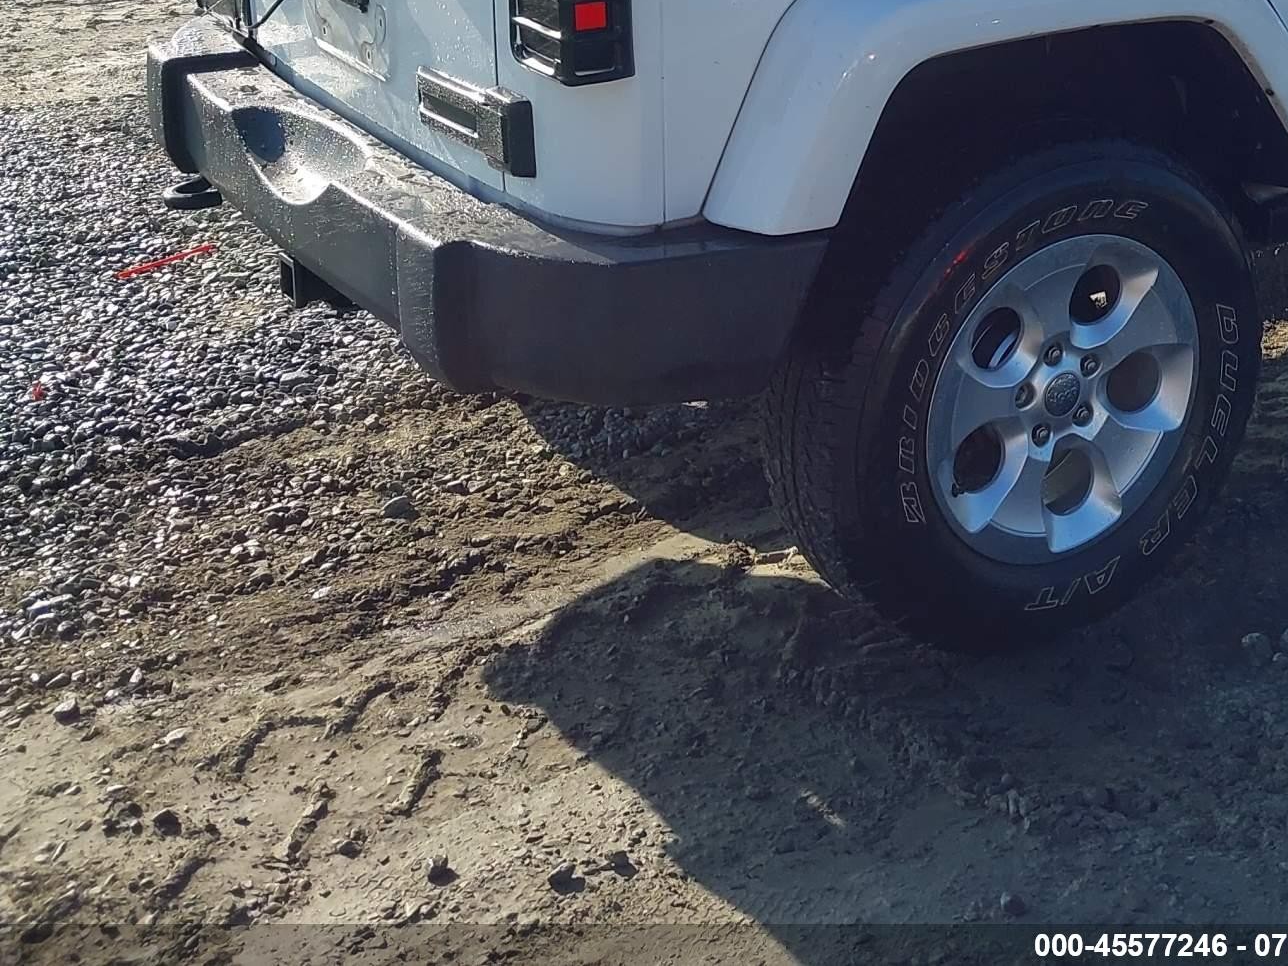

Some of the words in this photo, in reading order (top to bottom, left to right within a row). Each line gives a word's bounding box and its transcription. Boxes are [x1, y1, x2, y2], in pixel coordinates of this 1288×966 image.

[897, 197, 1149, 525] BRIDGESTONE
[1138, 302, 1241, 557] DUELER
[1024, 554, 1123, 612] A/T
